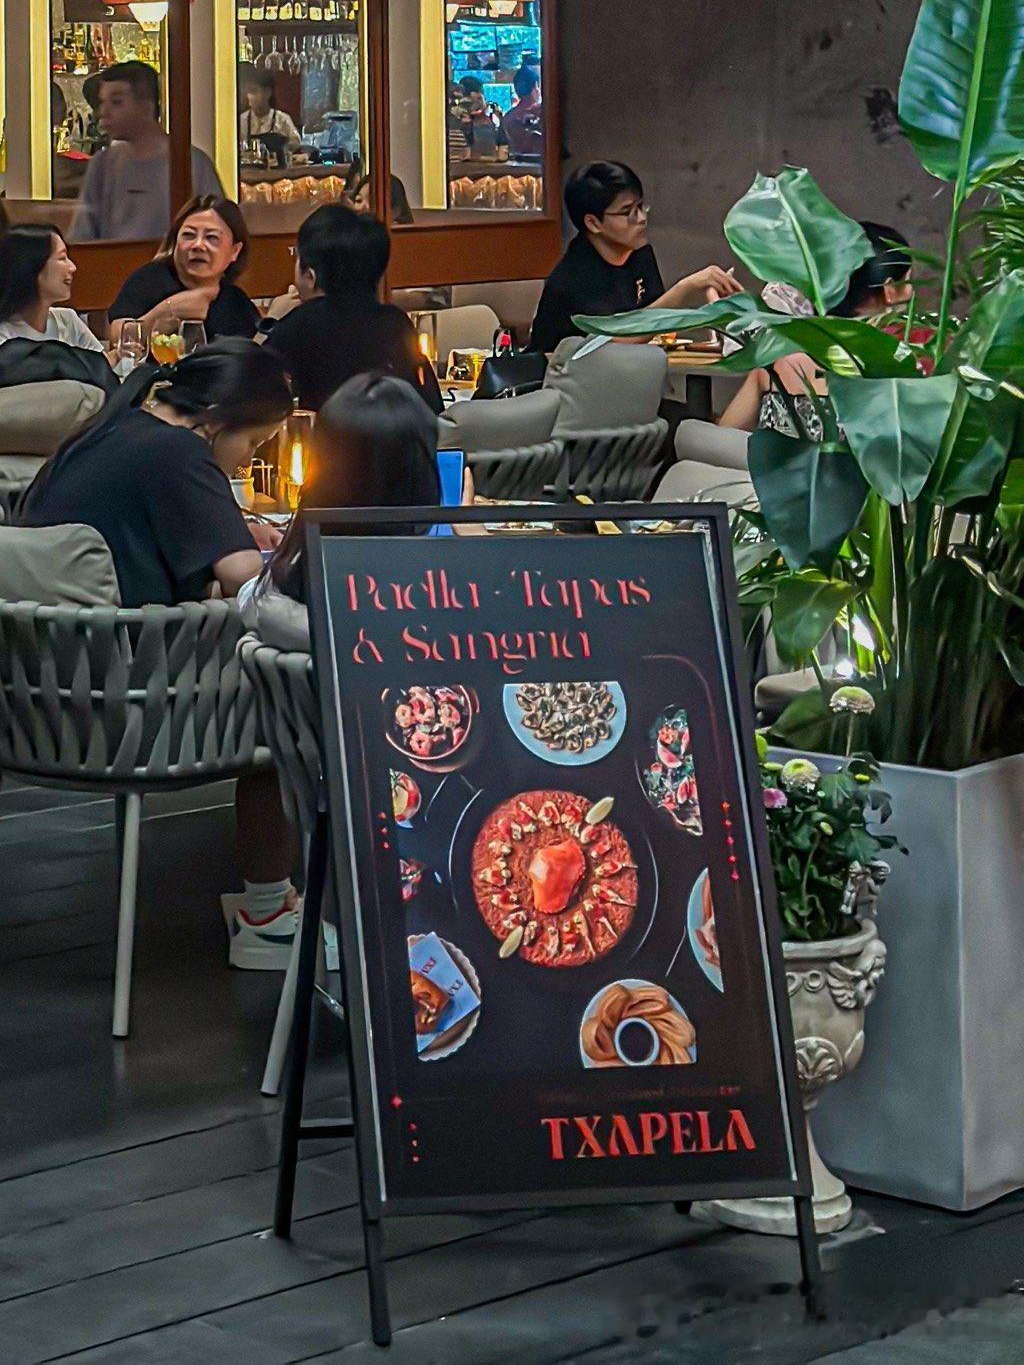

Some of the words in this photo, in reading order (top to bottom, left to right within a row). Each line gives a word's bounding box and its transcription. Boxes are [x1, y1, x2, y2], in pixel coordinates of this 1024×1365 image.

[347, 569, 480, 611] Paella
[511, 570, 652, 619] Tapas
[352, 627, 384, 664] &
[401, 624, 592, 675] Sangria
[540, 1108, 757, 1160] TXAPELA
